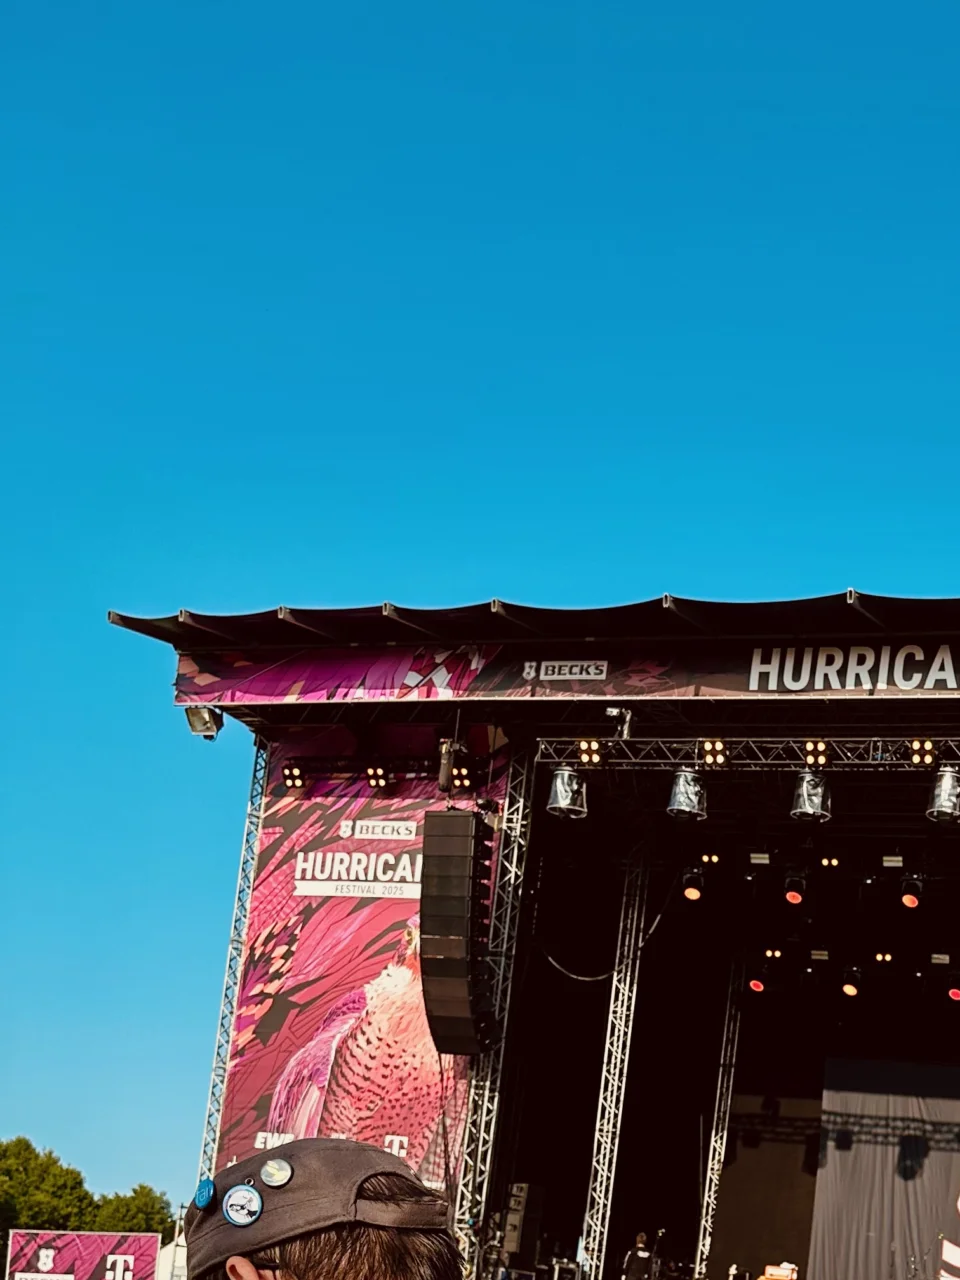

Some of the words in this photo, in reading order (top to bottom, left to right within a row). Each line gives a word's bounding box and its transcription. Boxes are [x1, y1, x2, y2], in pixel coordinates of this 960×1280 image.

[543, 661, 605, 677] BECK'S
[359, 823, 414, 836] BECK'S
[294, 851, 423, 883] HURRICA
[334, 884, 376, 895] FESTIVAL
[382, 885, 404, 896] 2025
